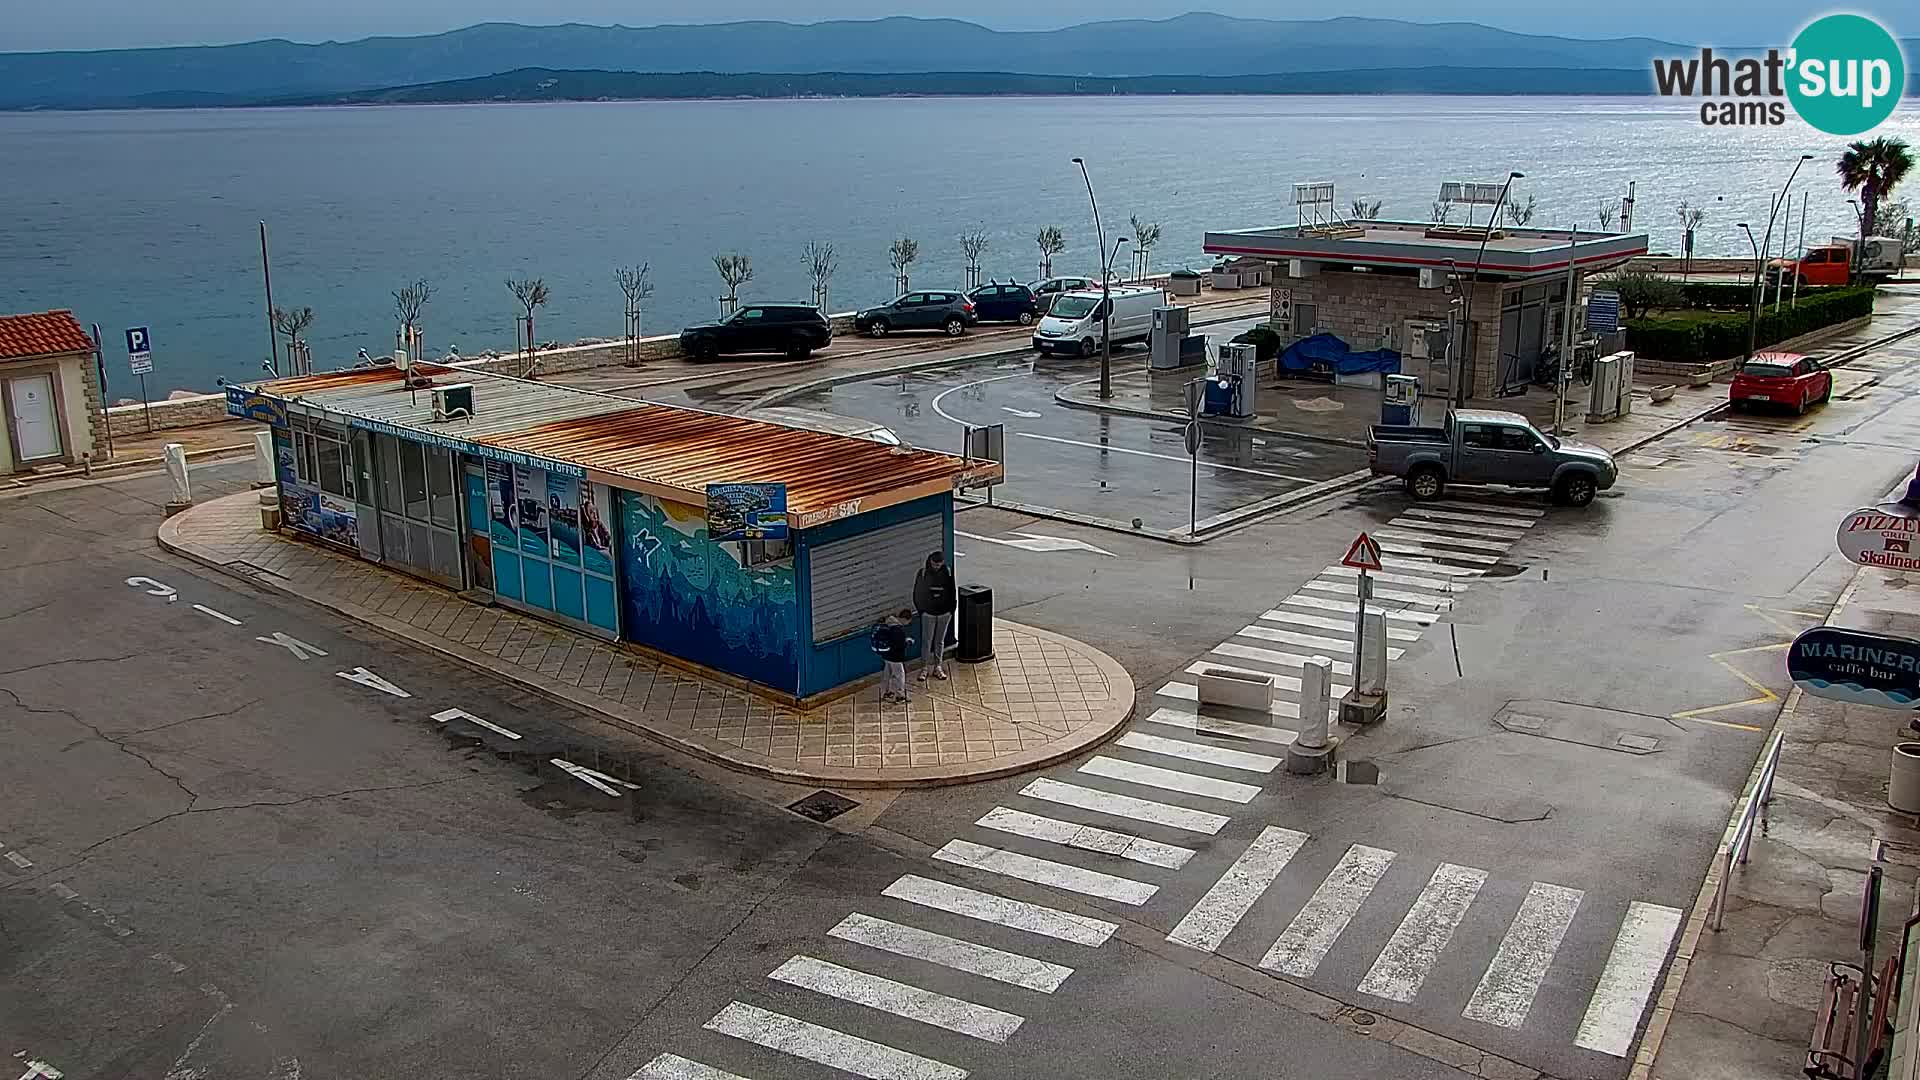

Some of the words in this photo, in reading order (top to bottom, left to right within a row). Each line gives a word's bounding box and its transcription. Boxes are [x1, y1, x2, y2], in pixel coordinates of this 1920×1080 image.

[131, 331, 143, 350] P
[437, 437, 469, 452] POSTAJA
[479, 447, 493, 458] BUS
[494, 450, 527, 465] STATION
[529, 457, 554, 471] TICKET
[556, 463, 583, 477] OFFICE
[1881, 531, 1917, 541] GRILL
[1828, 662, 1865, 675] caffe
[1870, 666, 1896, 680] bar
